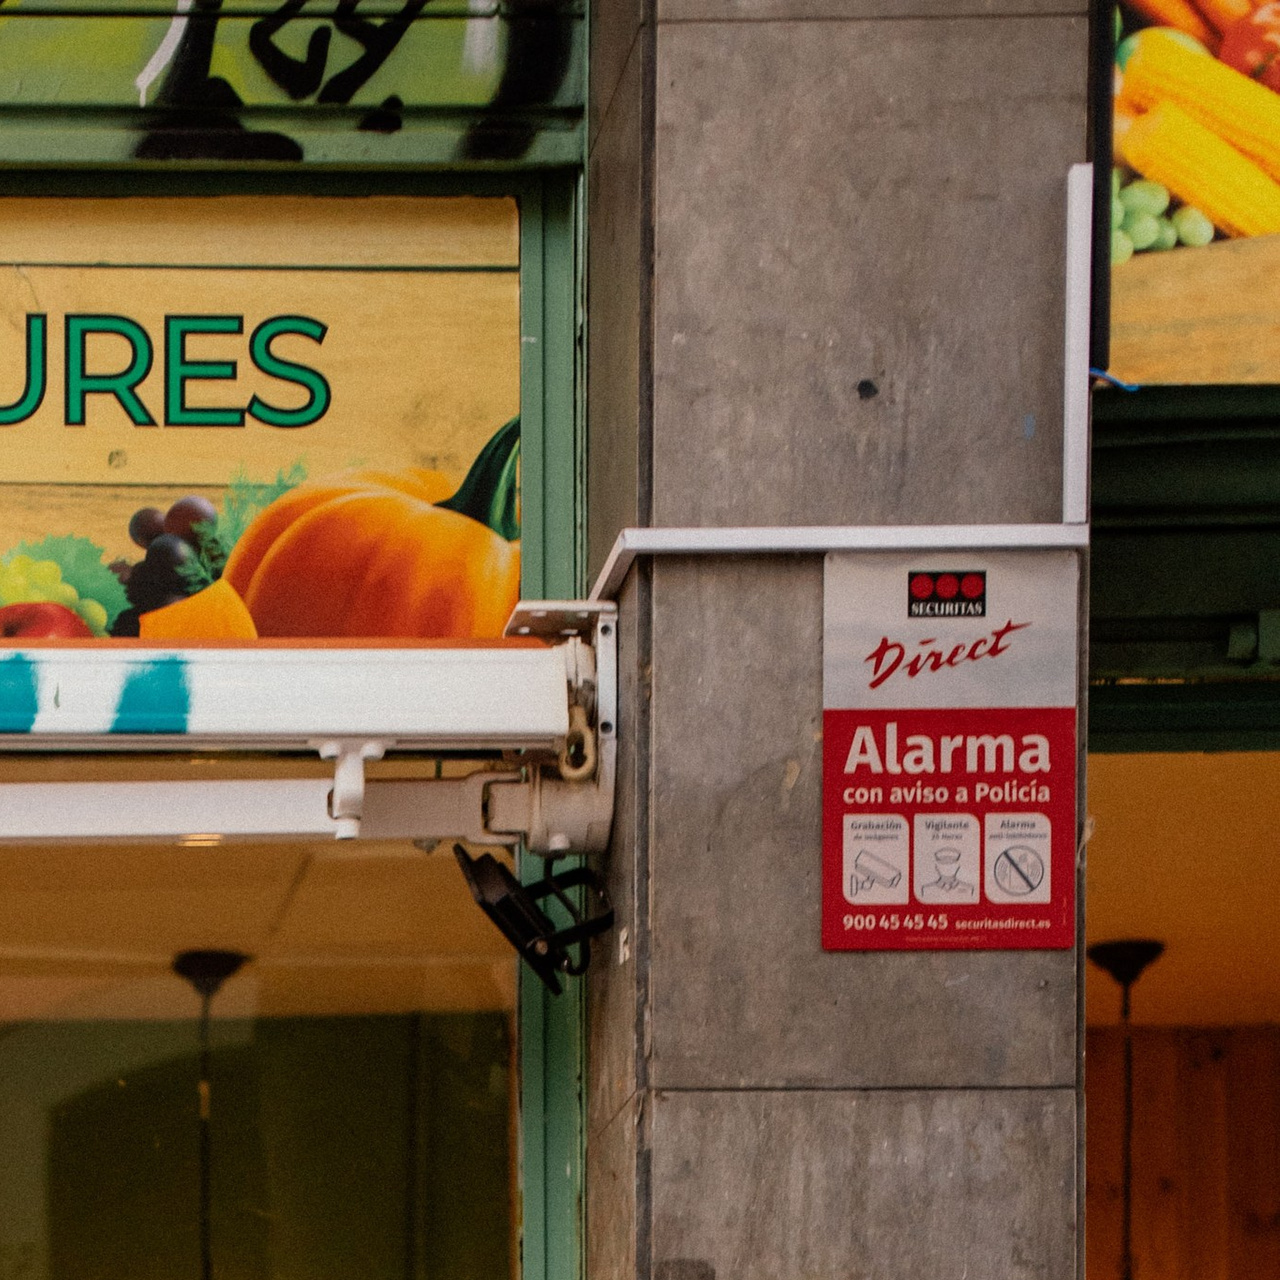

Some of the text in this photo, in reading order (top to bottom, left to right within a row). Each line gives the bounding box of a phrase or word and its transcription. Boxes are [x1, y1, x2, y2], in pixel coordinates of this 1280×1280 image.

[911, 602, 983, 616] SECURITAS
[864, 618, 1033, 690] Direct
[843, 721, 1052, 775] Alarma
[843, 779, 1051, 804] con aviso a Policía
[999, 819, 1037, 830] Alarma
[843, 914, 1051, 931] 900 45 45 45 securitasdirect.es
